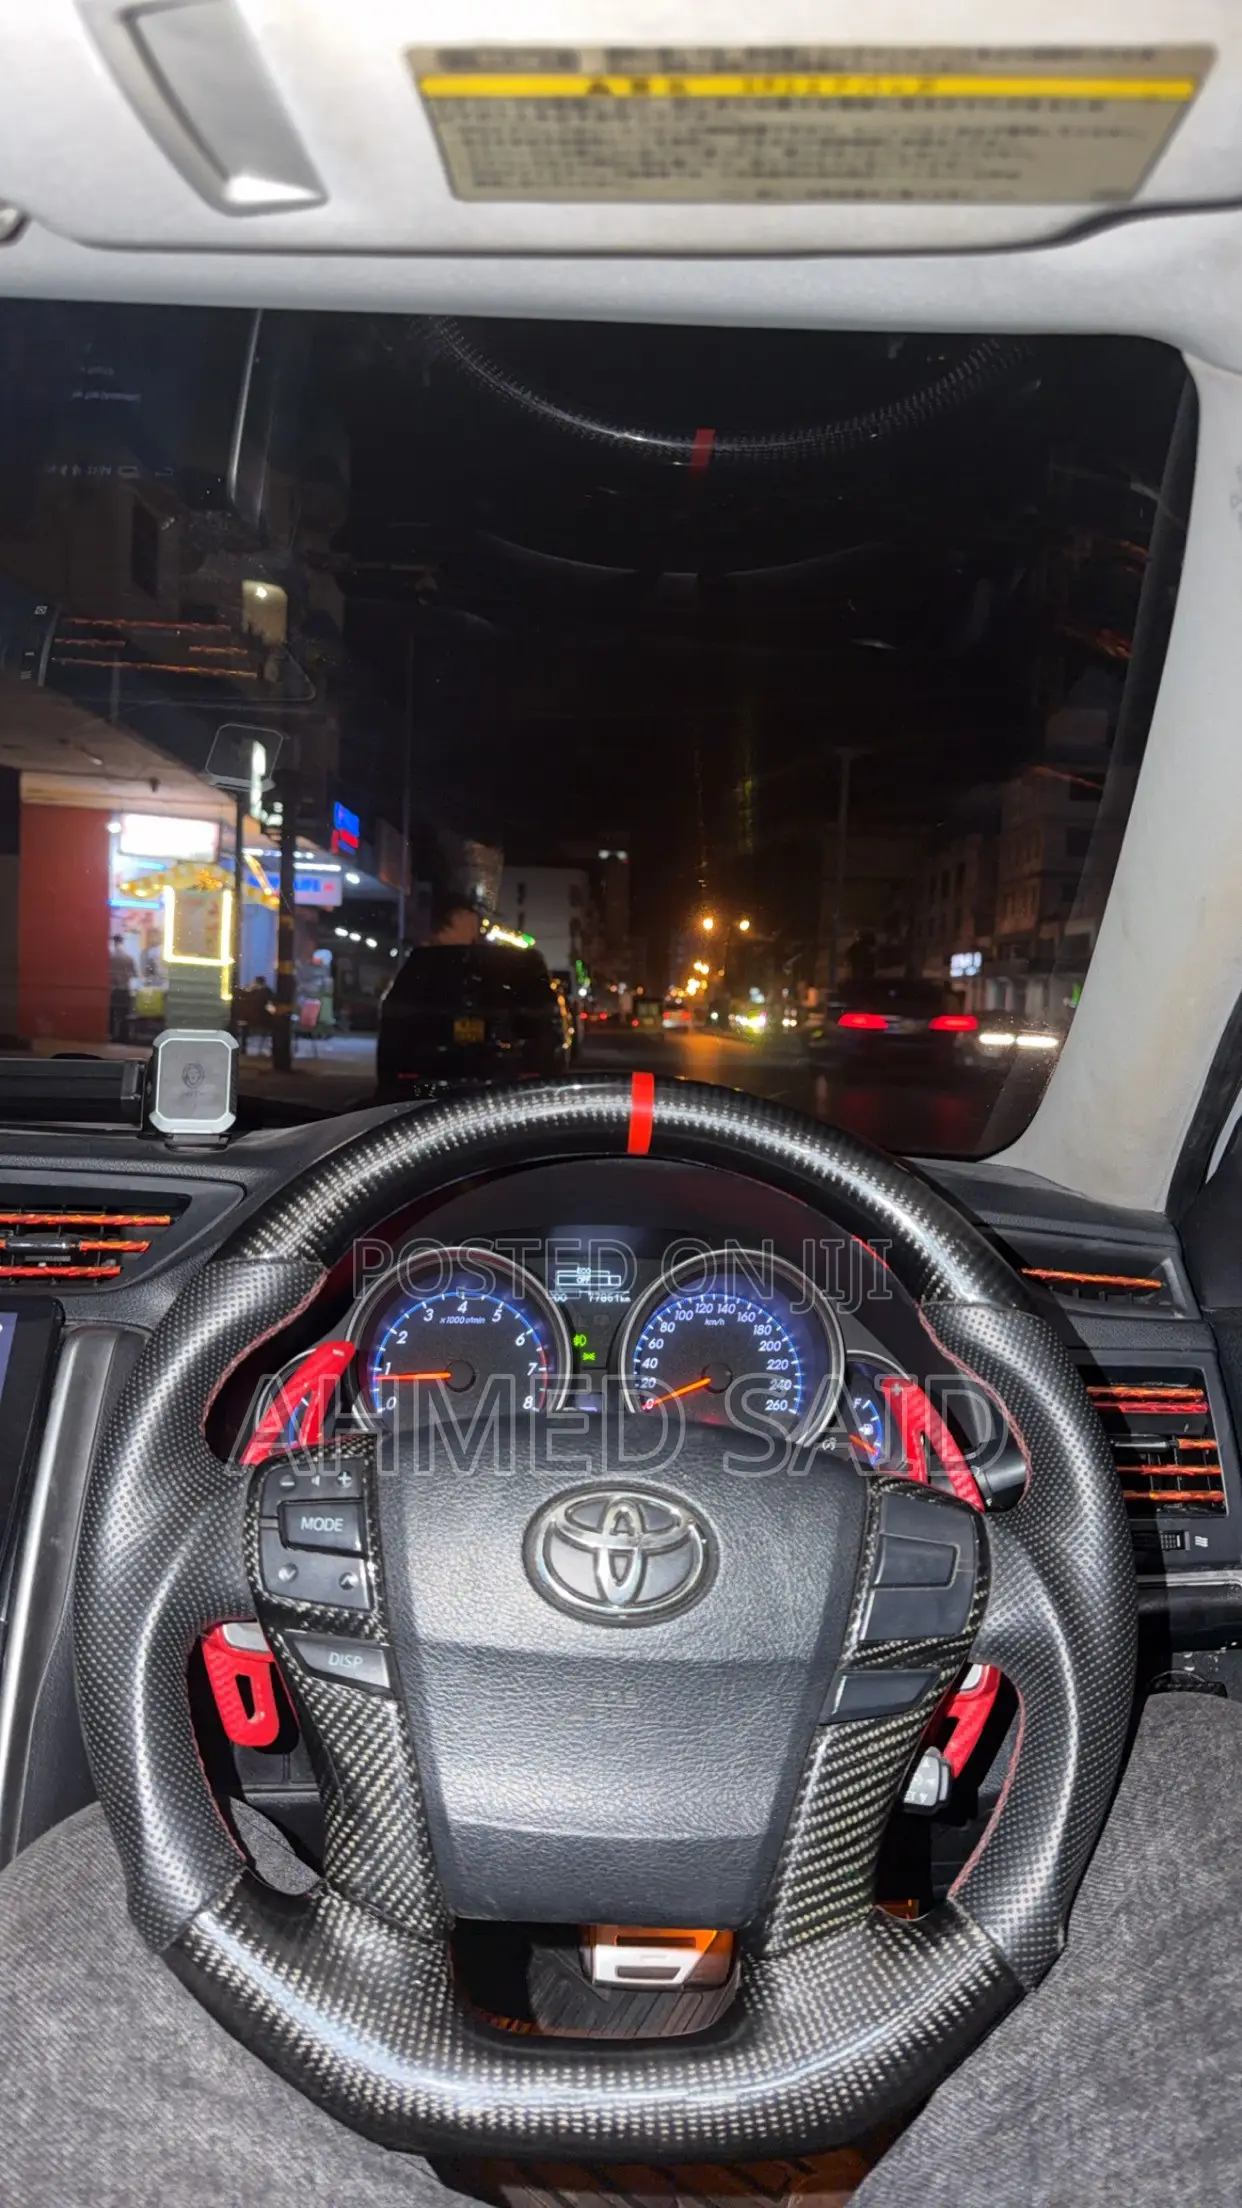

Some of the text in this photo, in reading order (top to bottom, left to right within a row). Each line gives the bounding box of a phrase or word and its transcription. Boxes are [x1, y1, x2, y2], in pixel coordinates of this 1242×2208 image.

[457, 1300, 468, 1314] 4
[695, 1303, 714, 1314] 120
[717, 1303, 736, 1314] 140
[423, 1309, 434, 1322] 3
[491, 1310, 502, 1323] 5
[674, 1310, 694, 1321] 100
[737, 1312, 756, 1323] 160
[659, 1322, 676, 1333] 80
[704, 1318, 725, 1326] km/h
[753, 1325, 772, 1336] 180
[396, 1330, 408, 1344] 2
[515, 1332, 526, 1346] 6
[648, 1338, 664, 1349] 60
[758, 1340, 782, 1352] 200
[384, 1361, 392, 1375] 1
[527, 1362, 538, 1376] 7
[641, 1357, 659, 1369] 40
[766, 1359, 789, 1370] 220
[640, 1377, 657, 1388] 20
[769, 1379, 792, 1391] 240
[386, 1396, 397, 1409] 0
[522, 1396, 533, 1409] 8
[765, 1399, 788, 1411] 260
[853, 1397, 862, 1409] F
[301, 1516, 344, 1532] MODE
[328, 1652, 363, 1668] DISP
